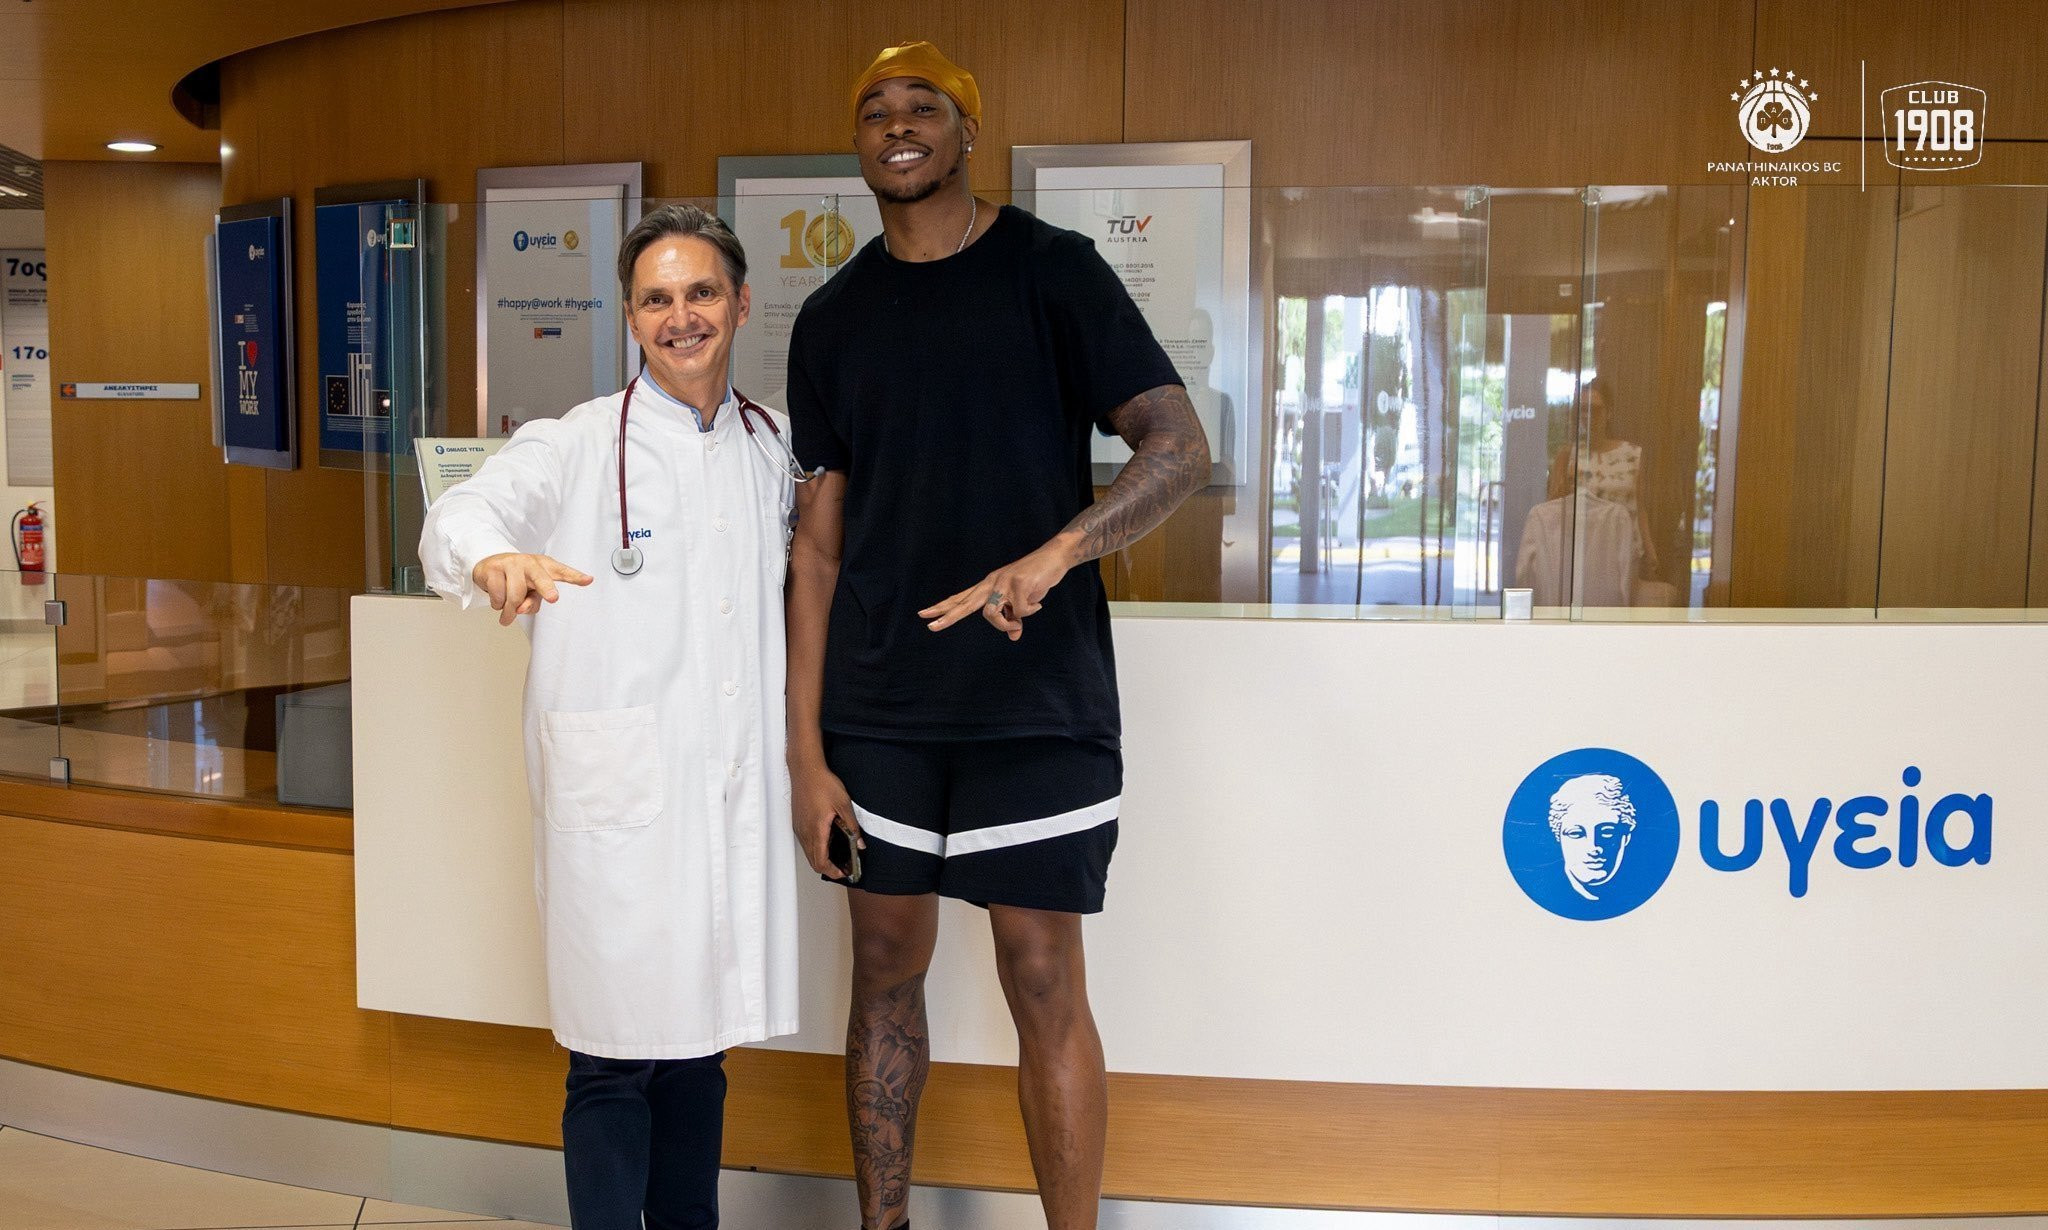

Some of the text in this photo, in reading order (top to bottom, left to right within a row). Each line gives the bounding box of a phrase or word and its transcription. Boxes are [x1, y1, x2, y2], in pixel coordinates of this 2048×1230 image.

[497, 297, 603, 310] #happy@work #hygeia
[13, 346, 48, 359] 17ο
[238, 341, 247, 370] I
[239, 371, 258, 400] MY
[239, 400, 260, 416] WORK
[627, 528, 652, 541] γεία
